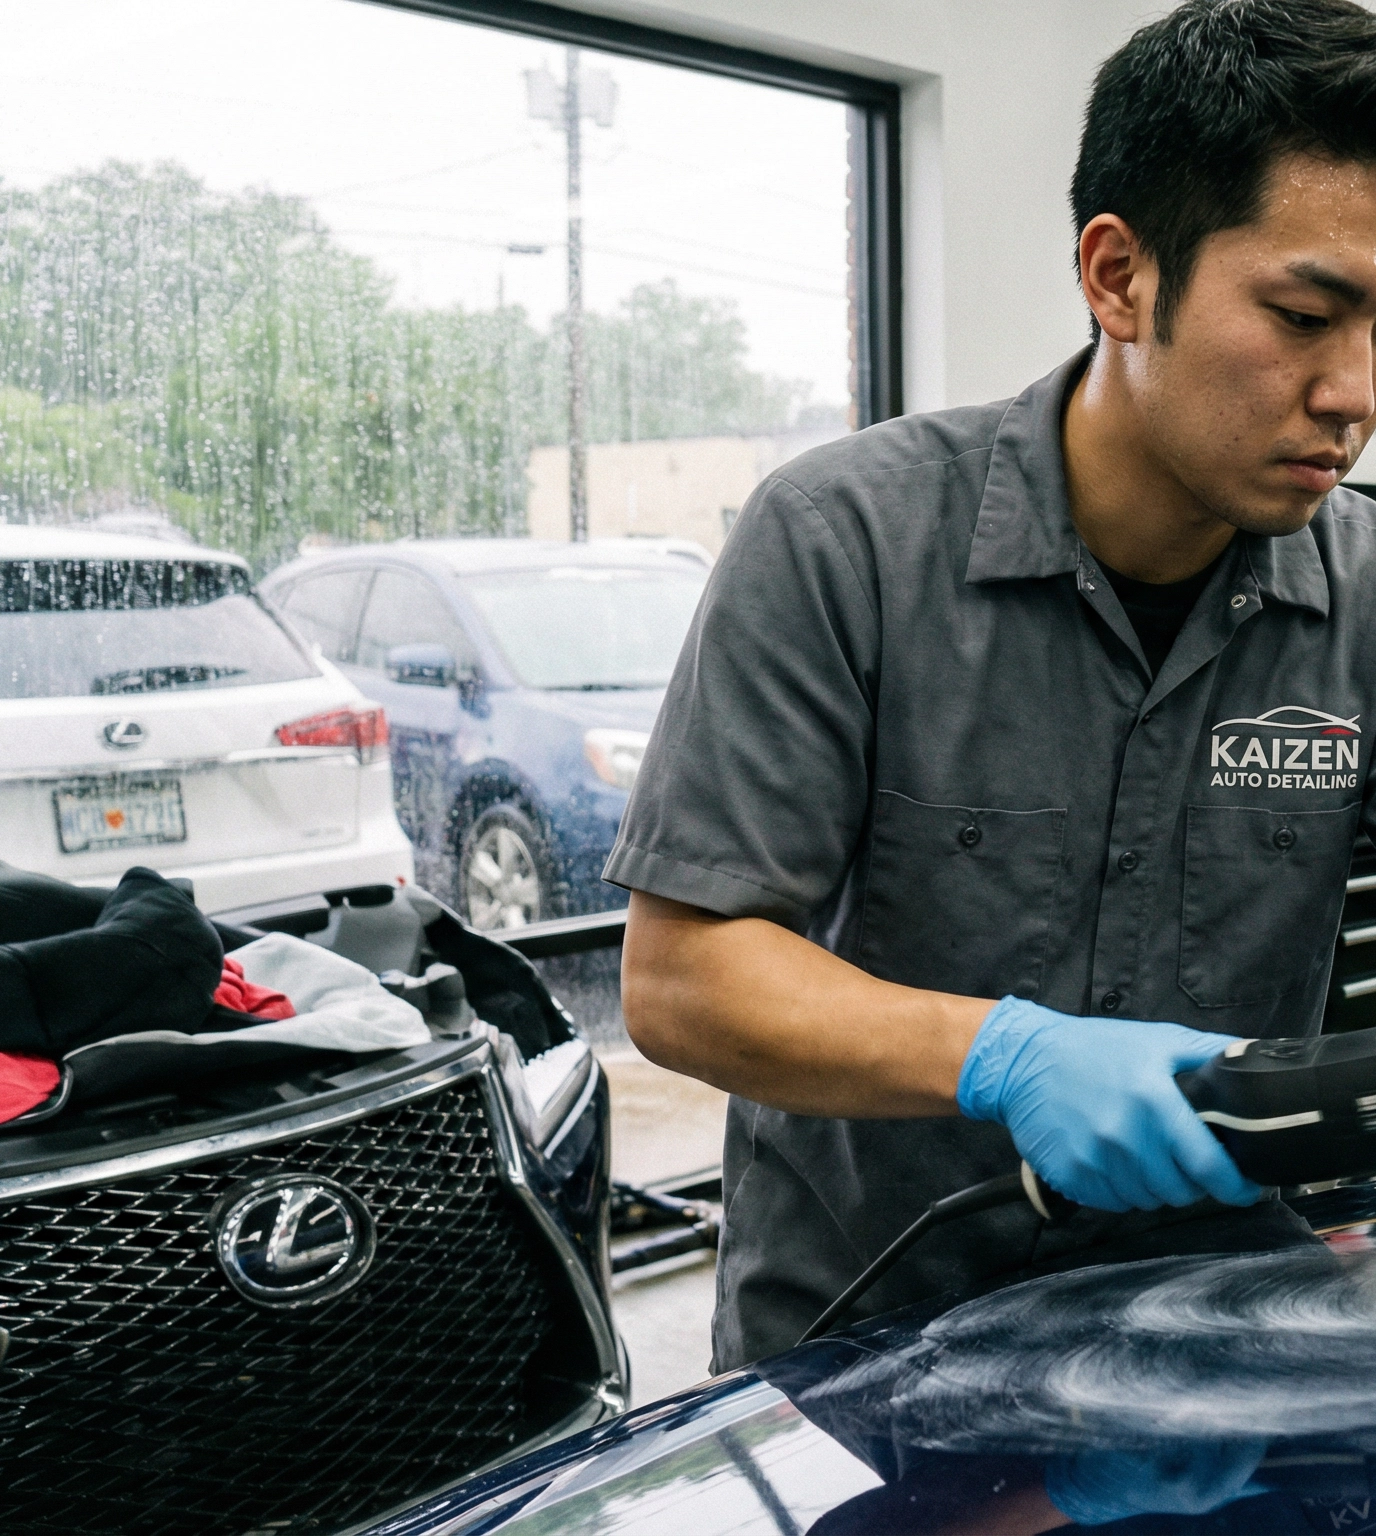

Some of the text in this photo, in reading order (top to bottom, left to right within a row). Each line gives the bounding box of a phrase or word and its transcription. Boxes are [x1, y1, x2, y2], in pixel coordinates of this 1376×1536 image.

[1210, 735, 1359, 770] KAIZEN
[1210, 771, 1357, 790] AUTO DETAILING
